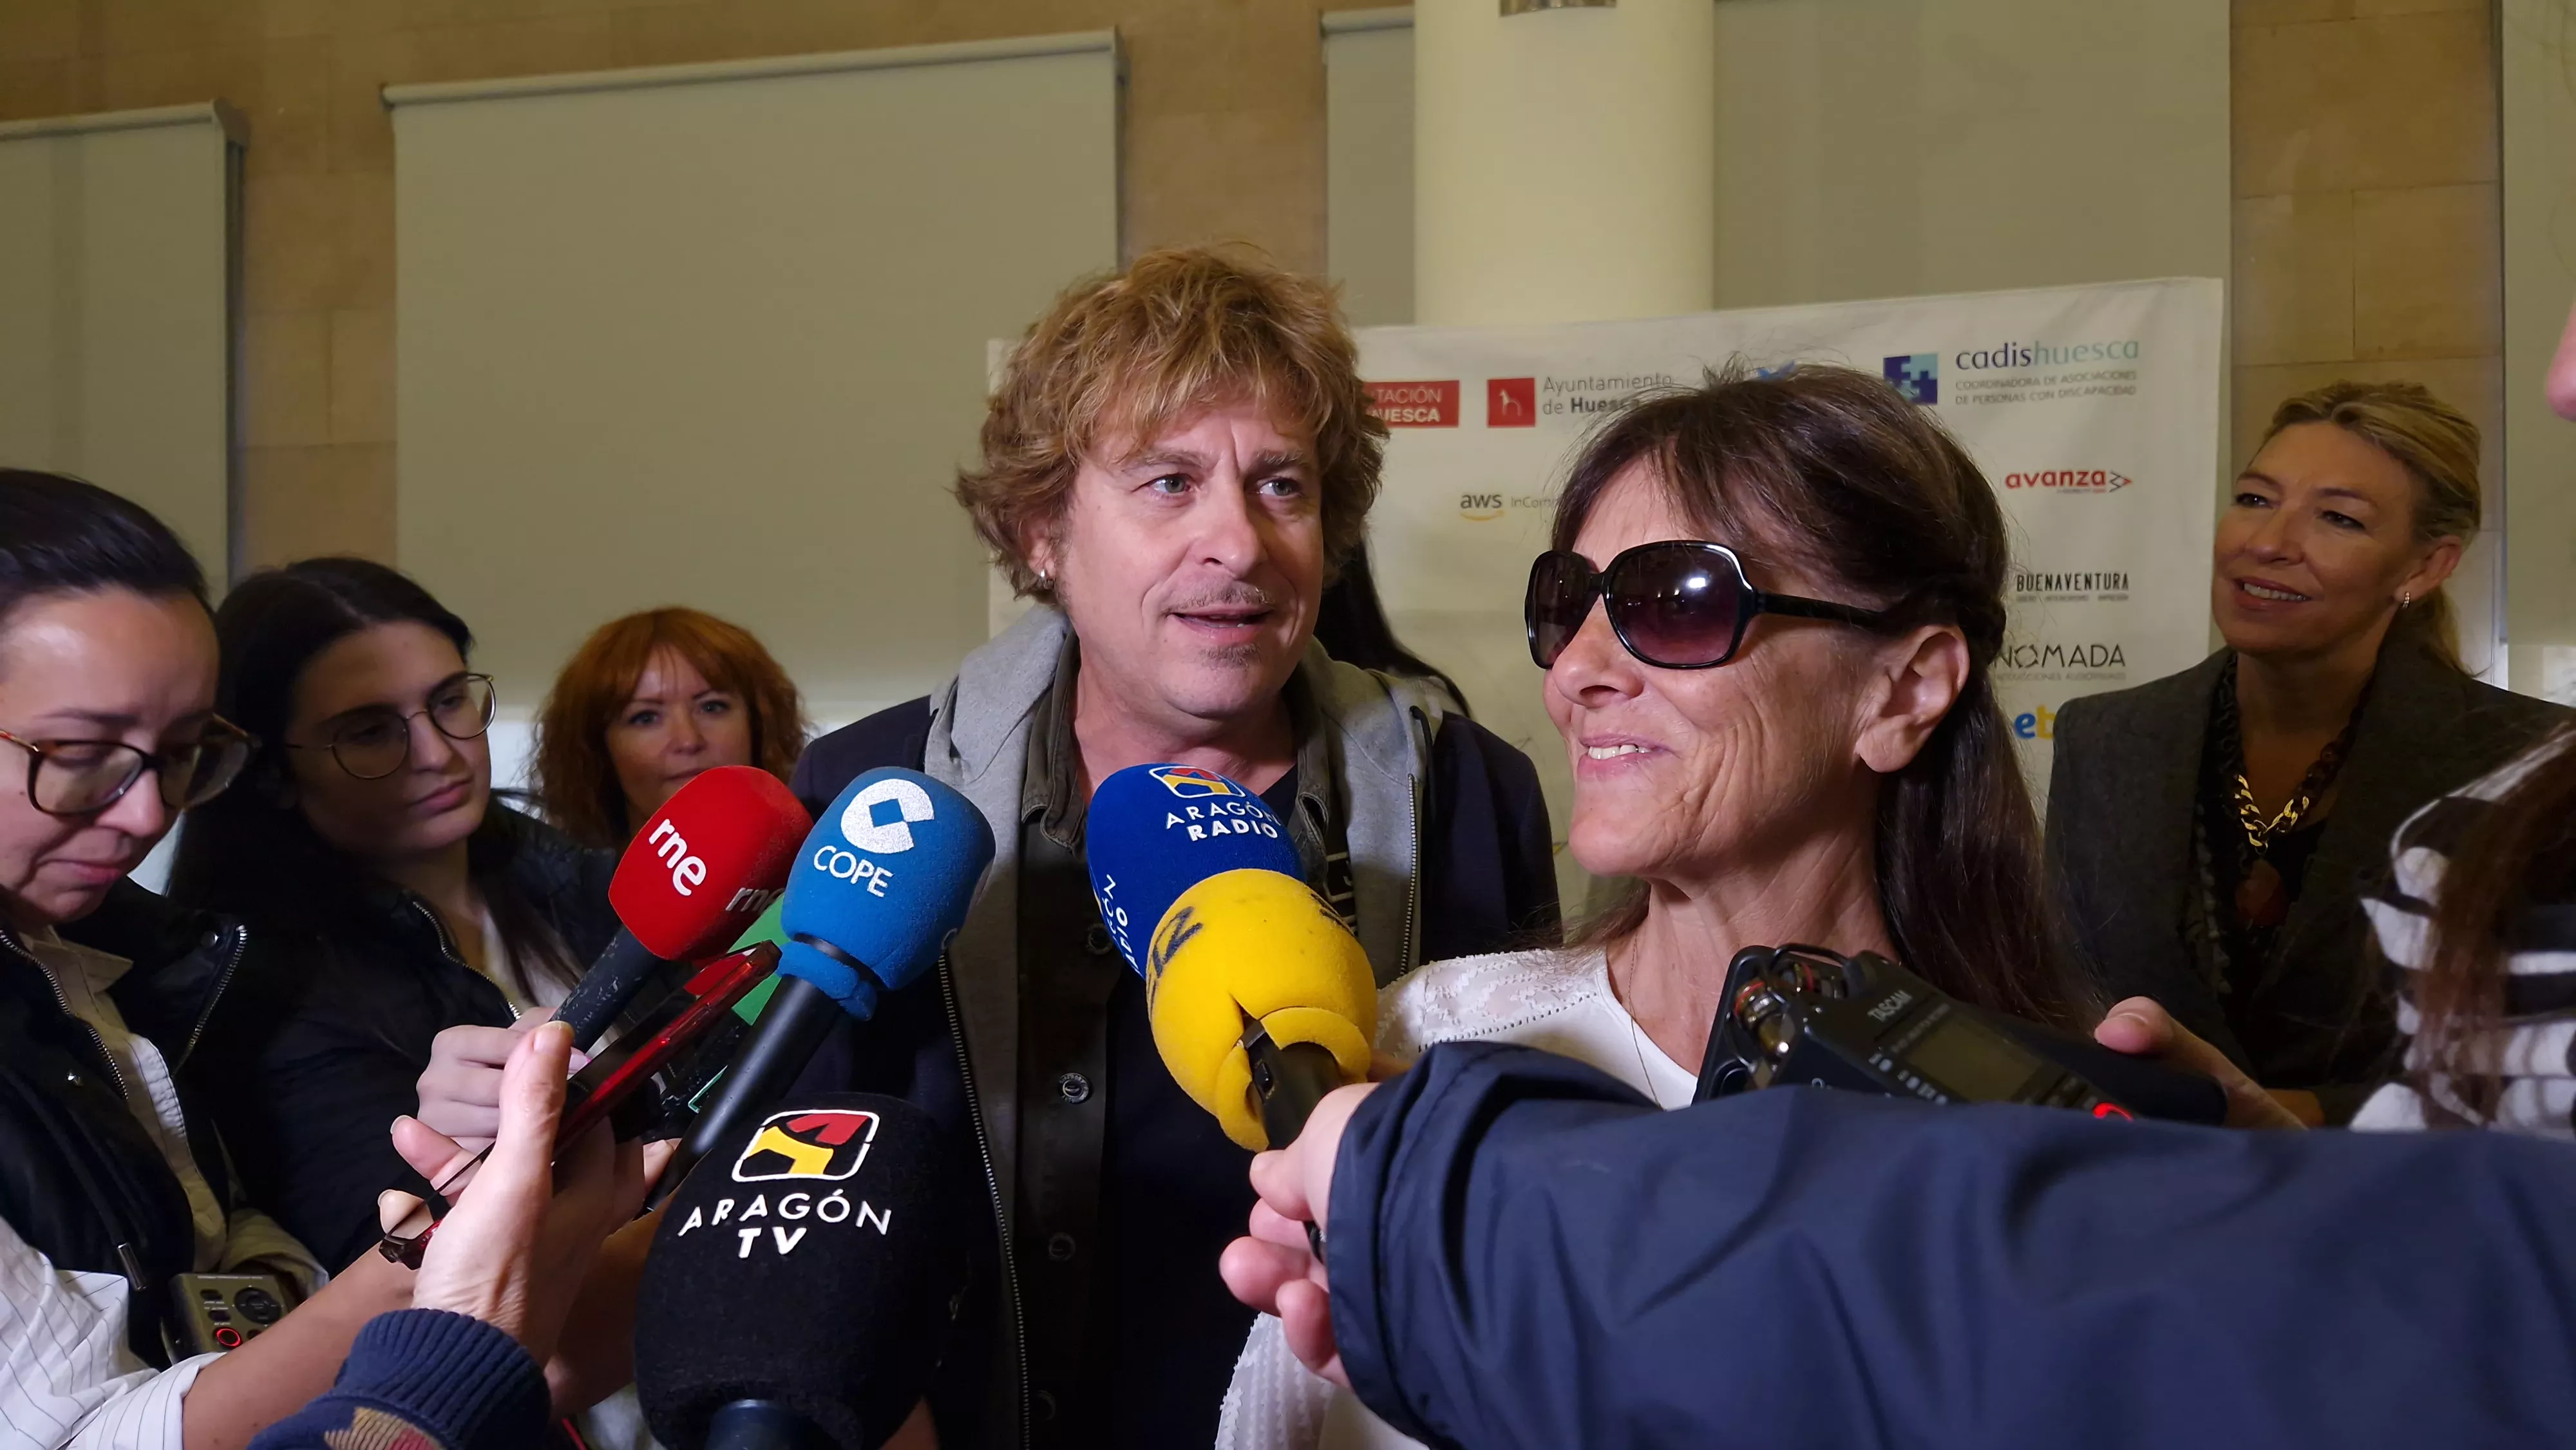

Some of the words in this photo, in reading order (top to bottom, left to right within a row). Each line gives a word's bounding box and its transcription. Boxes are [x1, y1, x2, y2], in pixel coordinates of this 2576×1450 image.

[1955, 340, 2139, 370] cadishuesca
[1543, 372, 1672, 397] Ayuntamiento
[2044, 375, 2058, 386] DE
[1376, 386, 1443, 404] TACIÓN
[1543, 399, 1564, 415] de
[1955, 395, 1969, 405] DE
[1973, 392, 2026, 405] PERSONAS
[2030, 390, 2055, 401] CON
[2005, 469, 2106, 489] avanza
[1460, 494, 1502, 509] aws
[2016, 572, 2129, 592] BUENAVENTURA
[1165, 800, 1282, 830] ARAGÓN
[1186, 818, 1278, 842] RADIO
[649, 818, 706, 896] rne
[813, 845, 894, 898] COPE
[1115, 907, 1142, 974] ADIO
[1867, 989, 1913, 1022] TASCAM
[677, 1189, 891, 1237] ARAGÓN
[738, 1227, 807, 1259] TV
